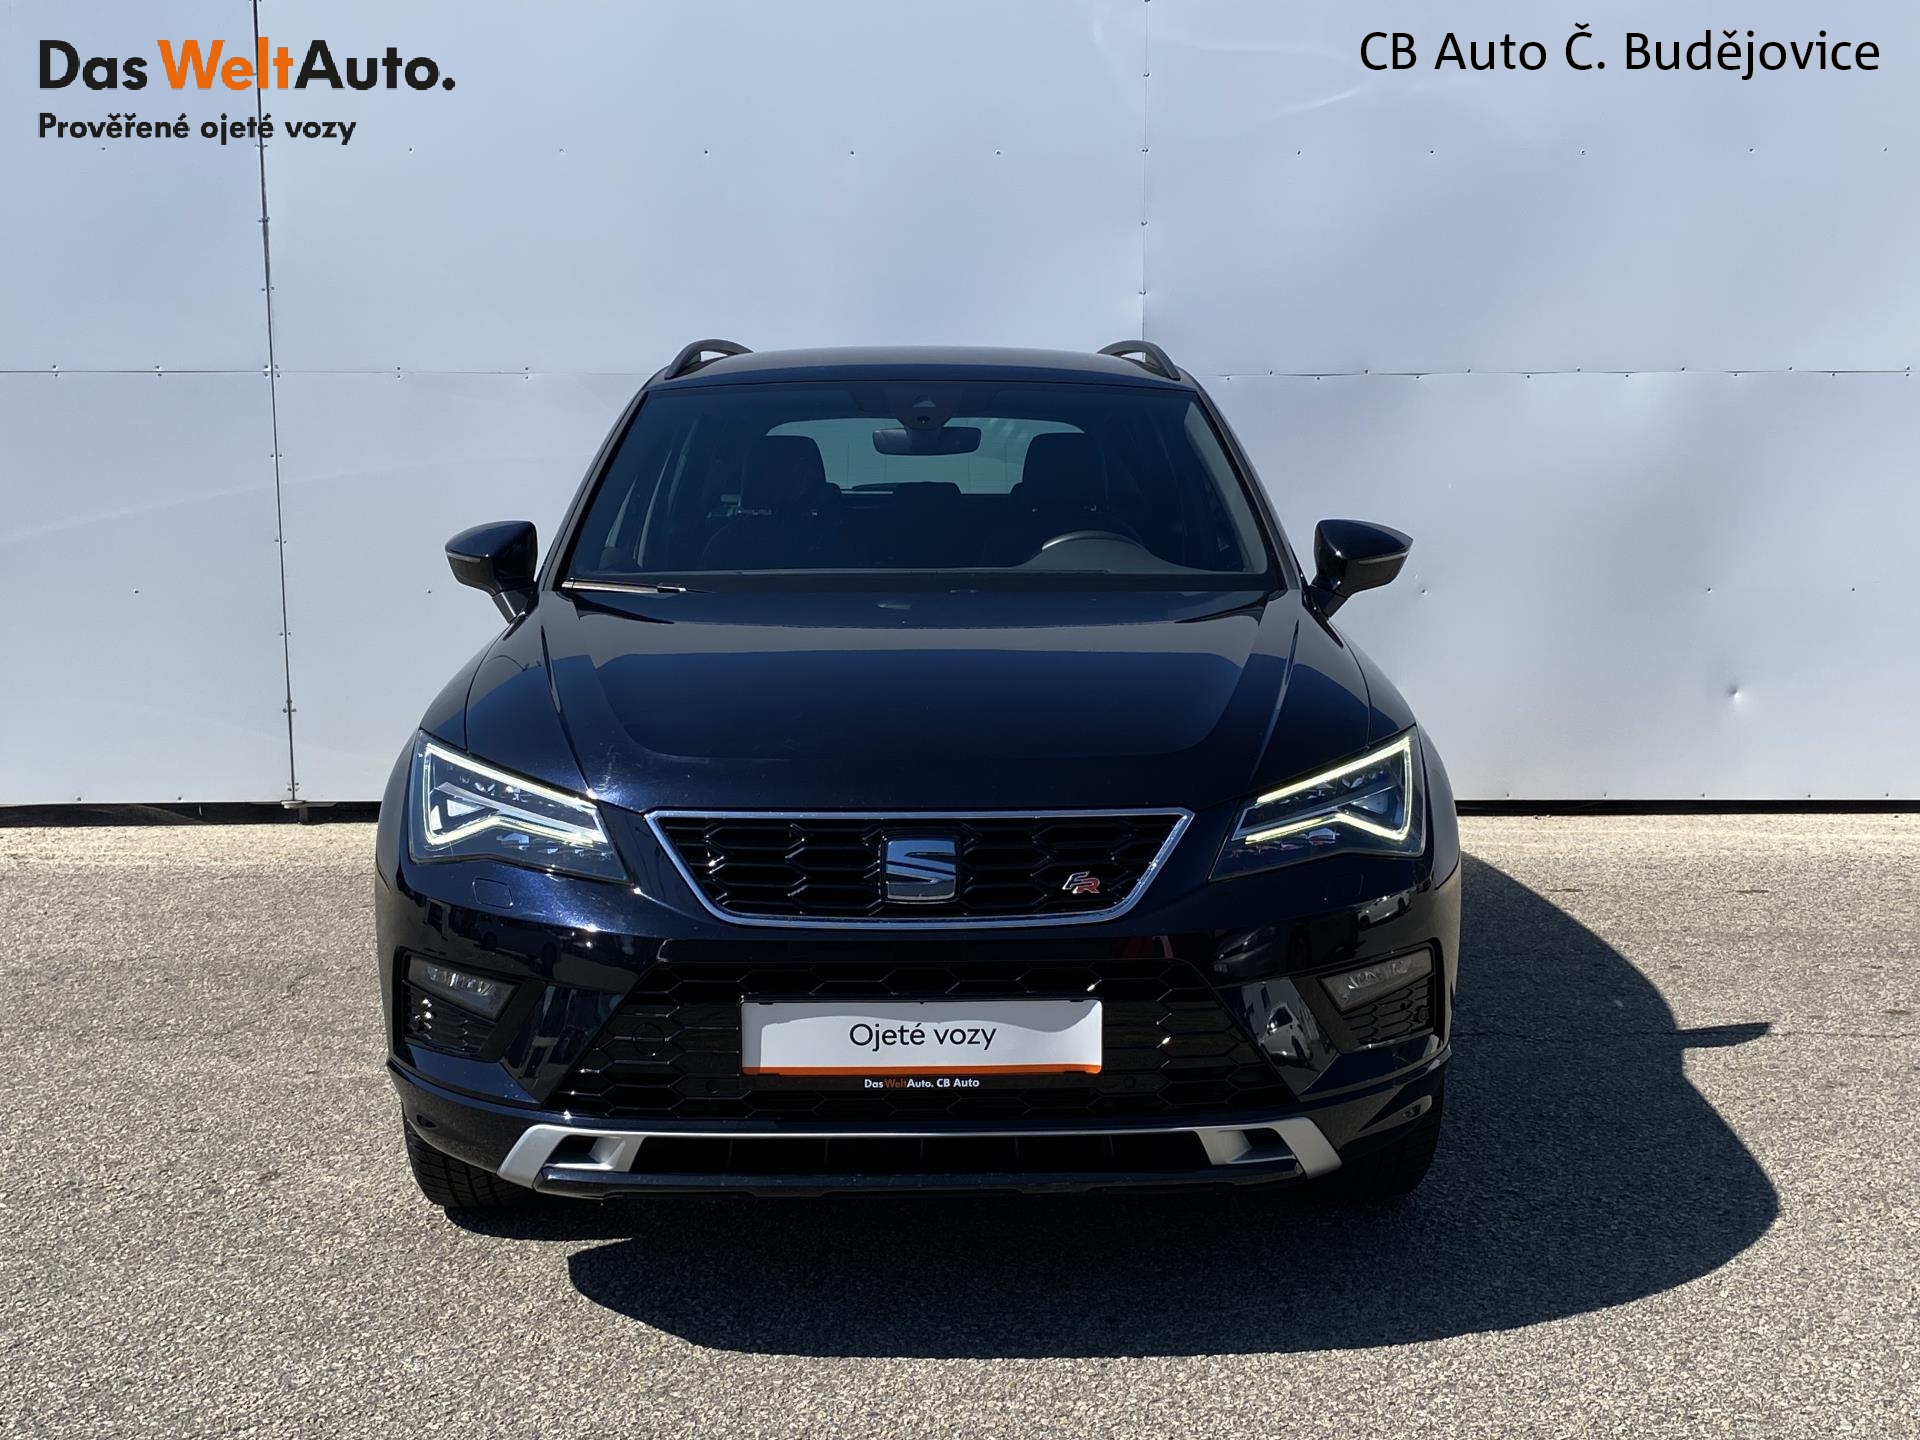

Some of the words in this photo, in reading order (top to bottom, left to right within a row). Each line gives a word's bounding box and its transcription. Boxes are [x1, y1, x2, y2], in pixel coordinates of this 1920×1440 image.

[849, 1022, 926, 1052] Ojeté
[933, 1028, 997, 1051] vozy
[936, 1078, 951, 1089] CB
[952, 1078, 980, 1088] Auto
